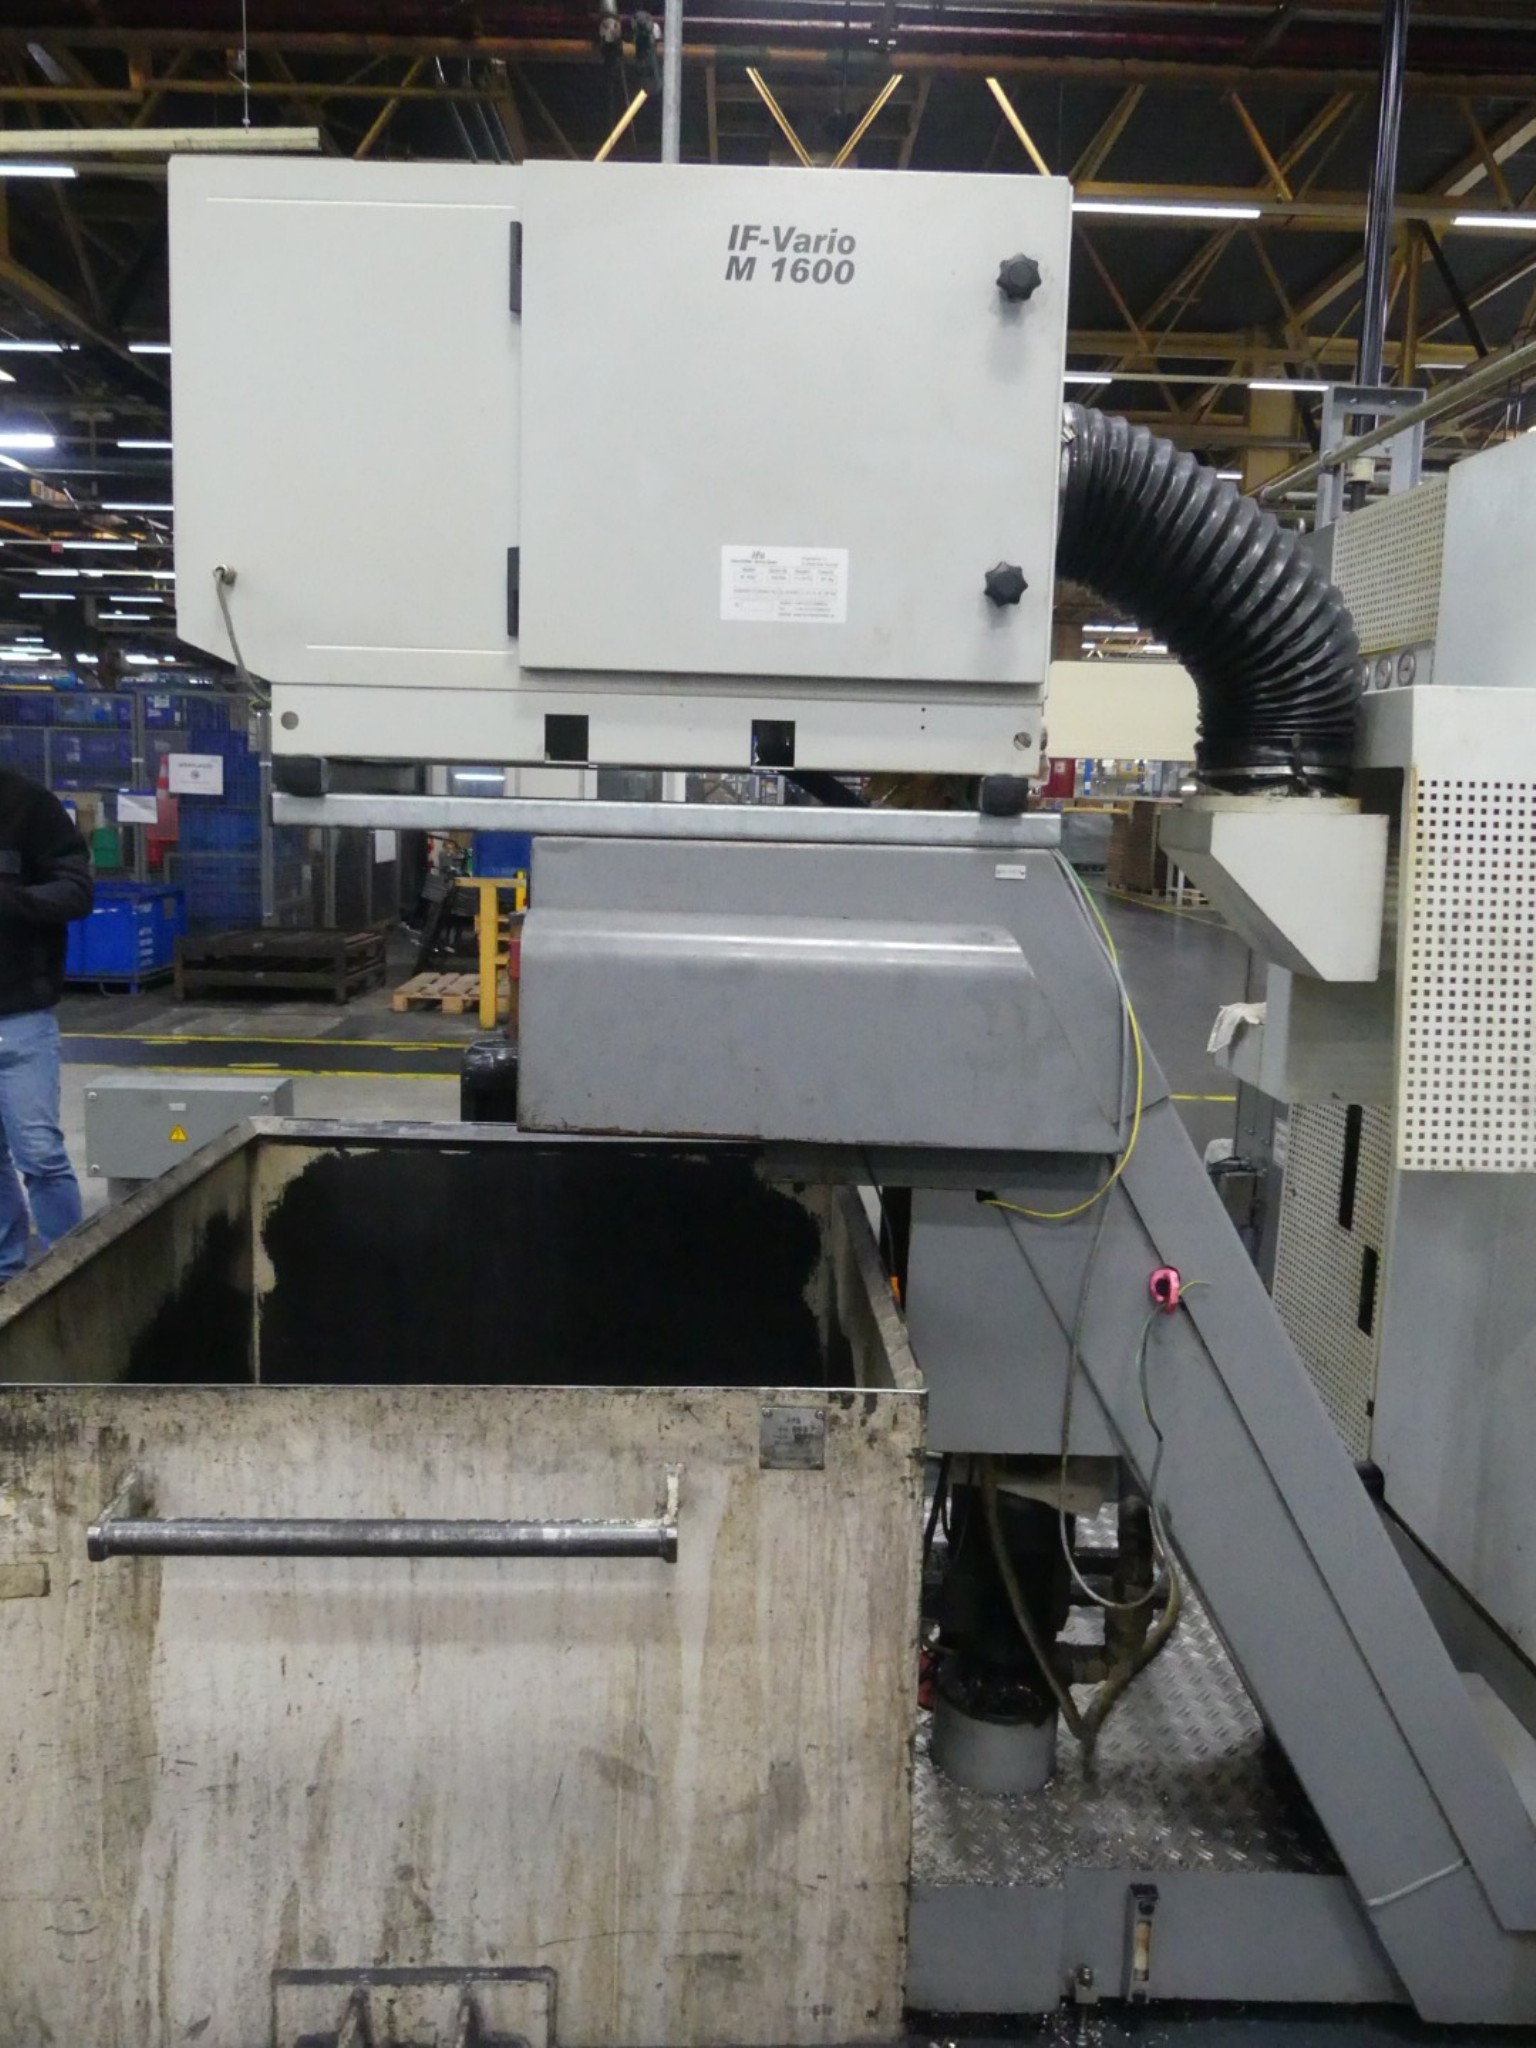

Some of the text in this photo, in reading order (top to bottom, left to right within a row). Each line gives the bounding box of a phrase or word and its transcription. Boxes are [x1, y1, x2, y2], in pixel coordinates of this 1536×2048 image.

[727, 224, 857, 255] IF-Vario
[725, 255, 856, 285] M 1600
